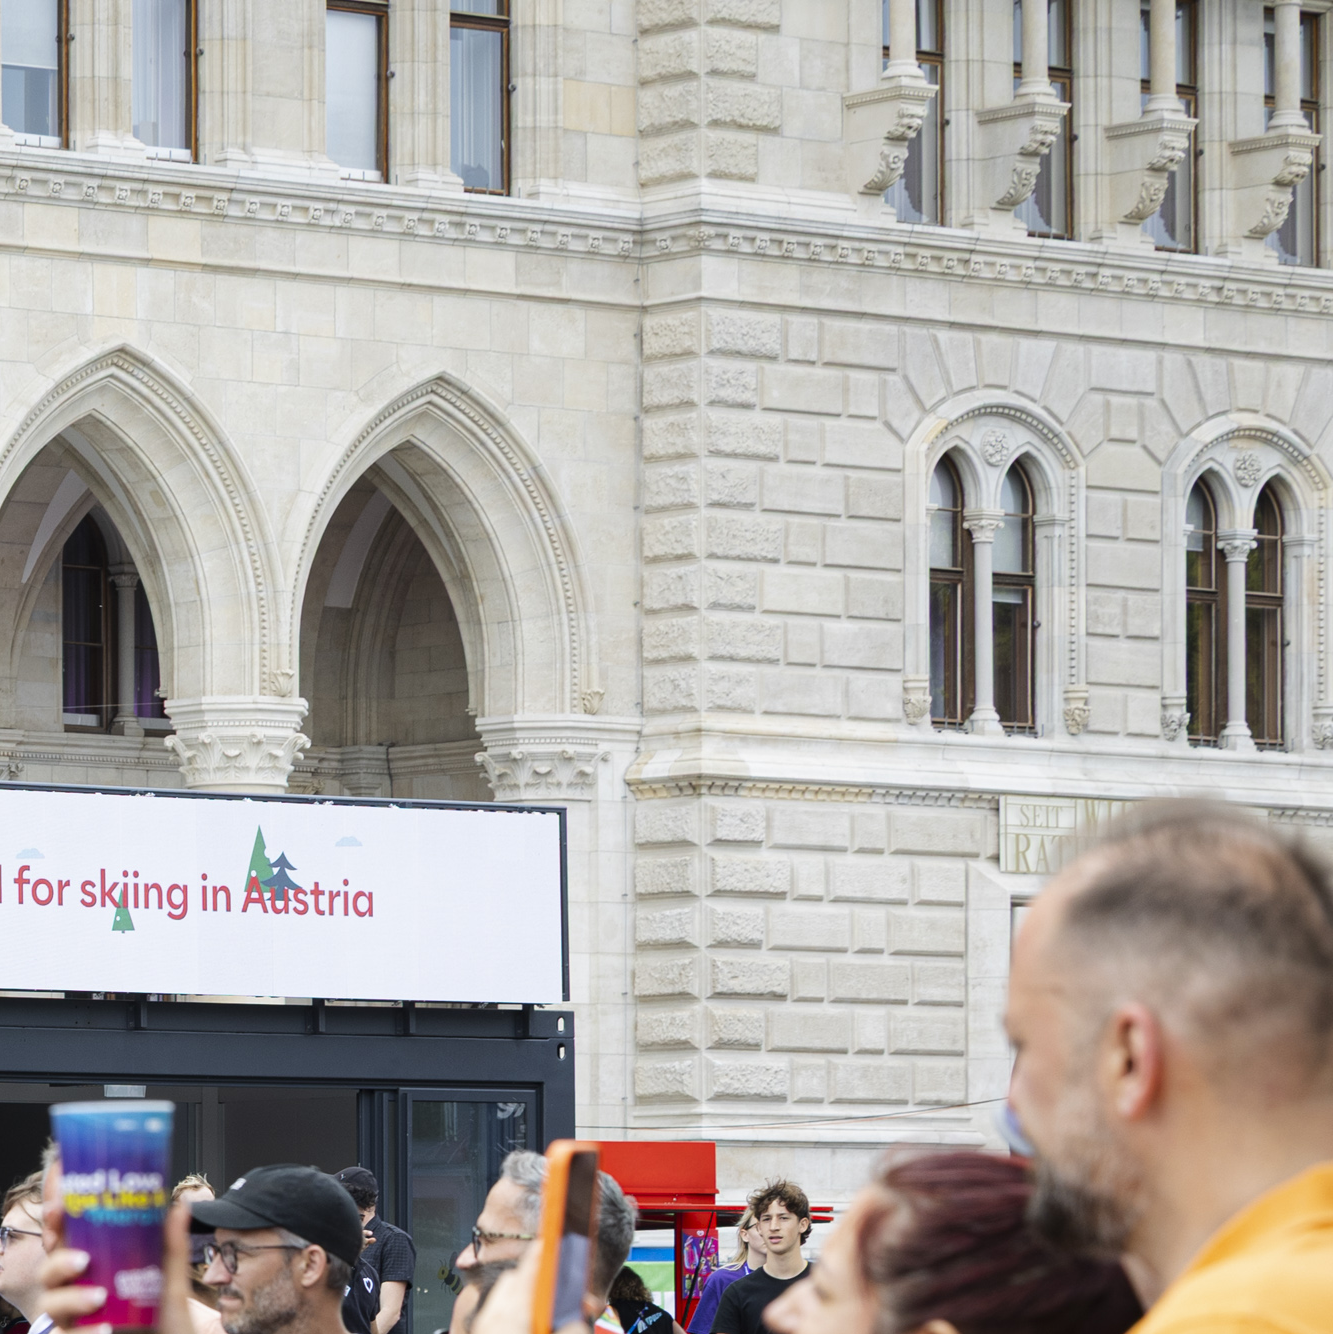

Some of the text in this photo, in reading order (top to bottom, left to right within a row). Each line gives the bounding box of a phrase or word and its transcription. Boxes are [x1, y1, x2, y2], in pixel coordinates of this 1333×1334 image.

[1020, 804, 1064, 829] SEIT
[15, 865, 70, 905] for
[81, 869, 187, 919] skiing
[202, 874, 230, 910] in
[243, 877, 372, 916] Austria
